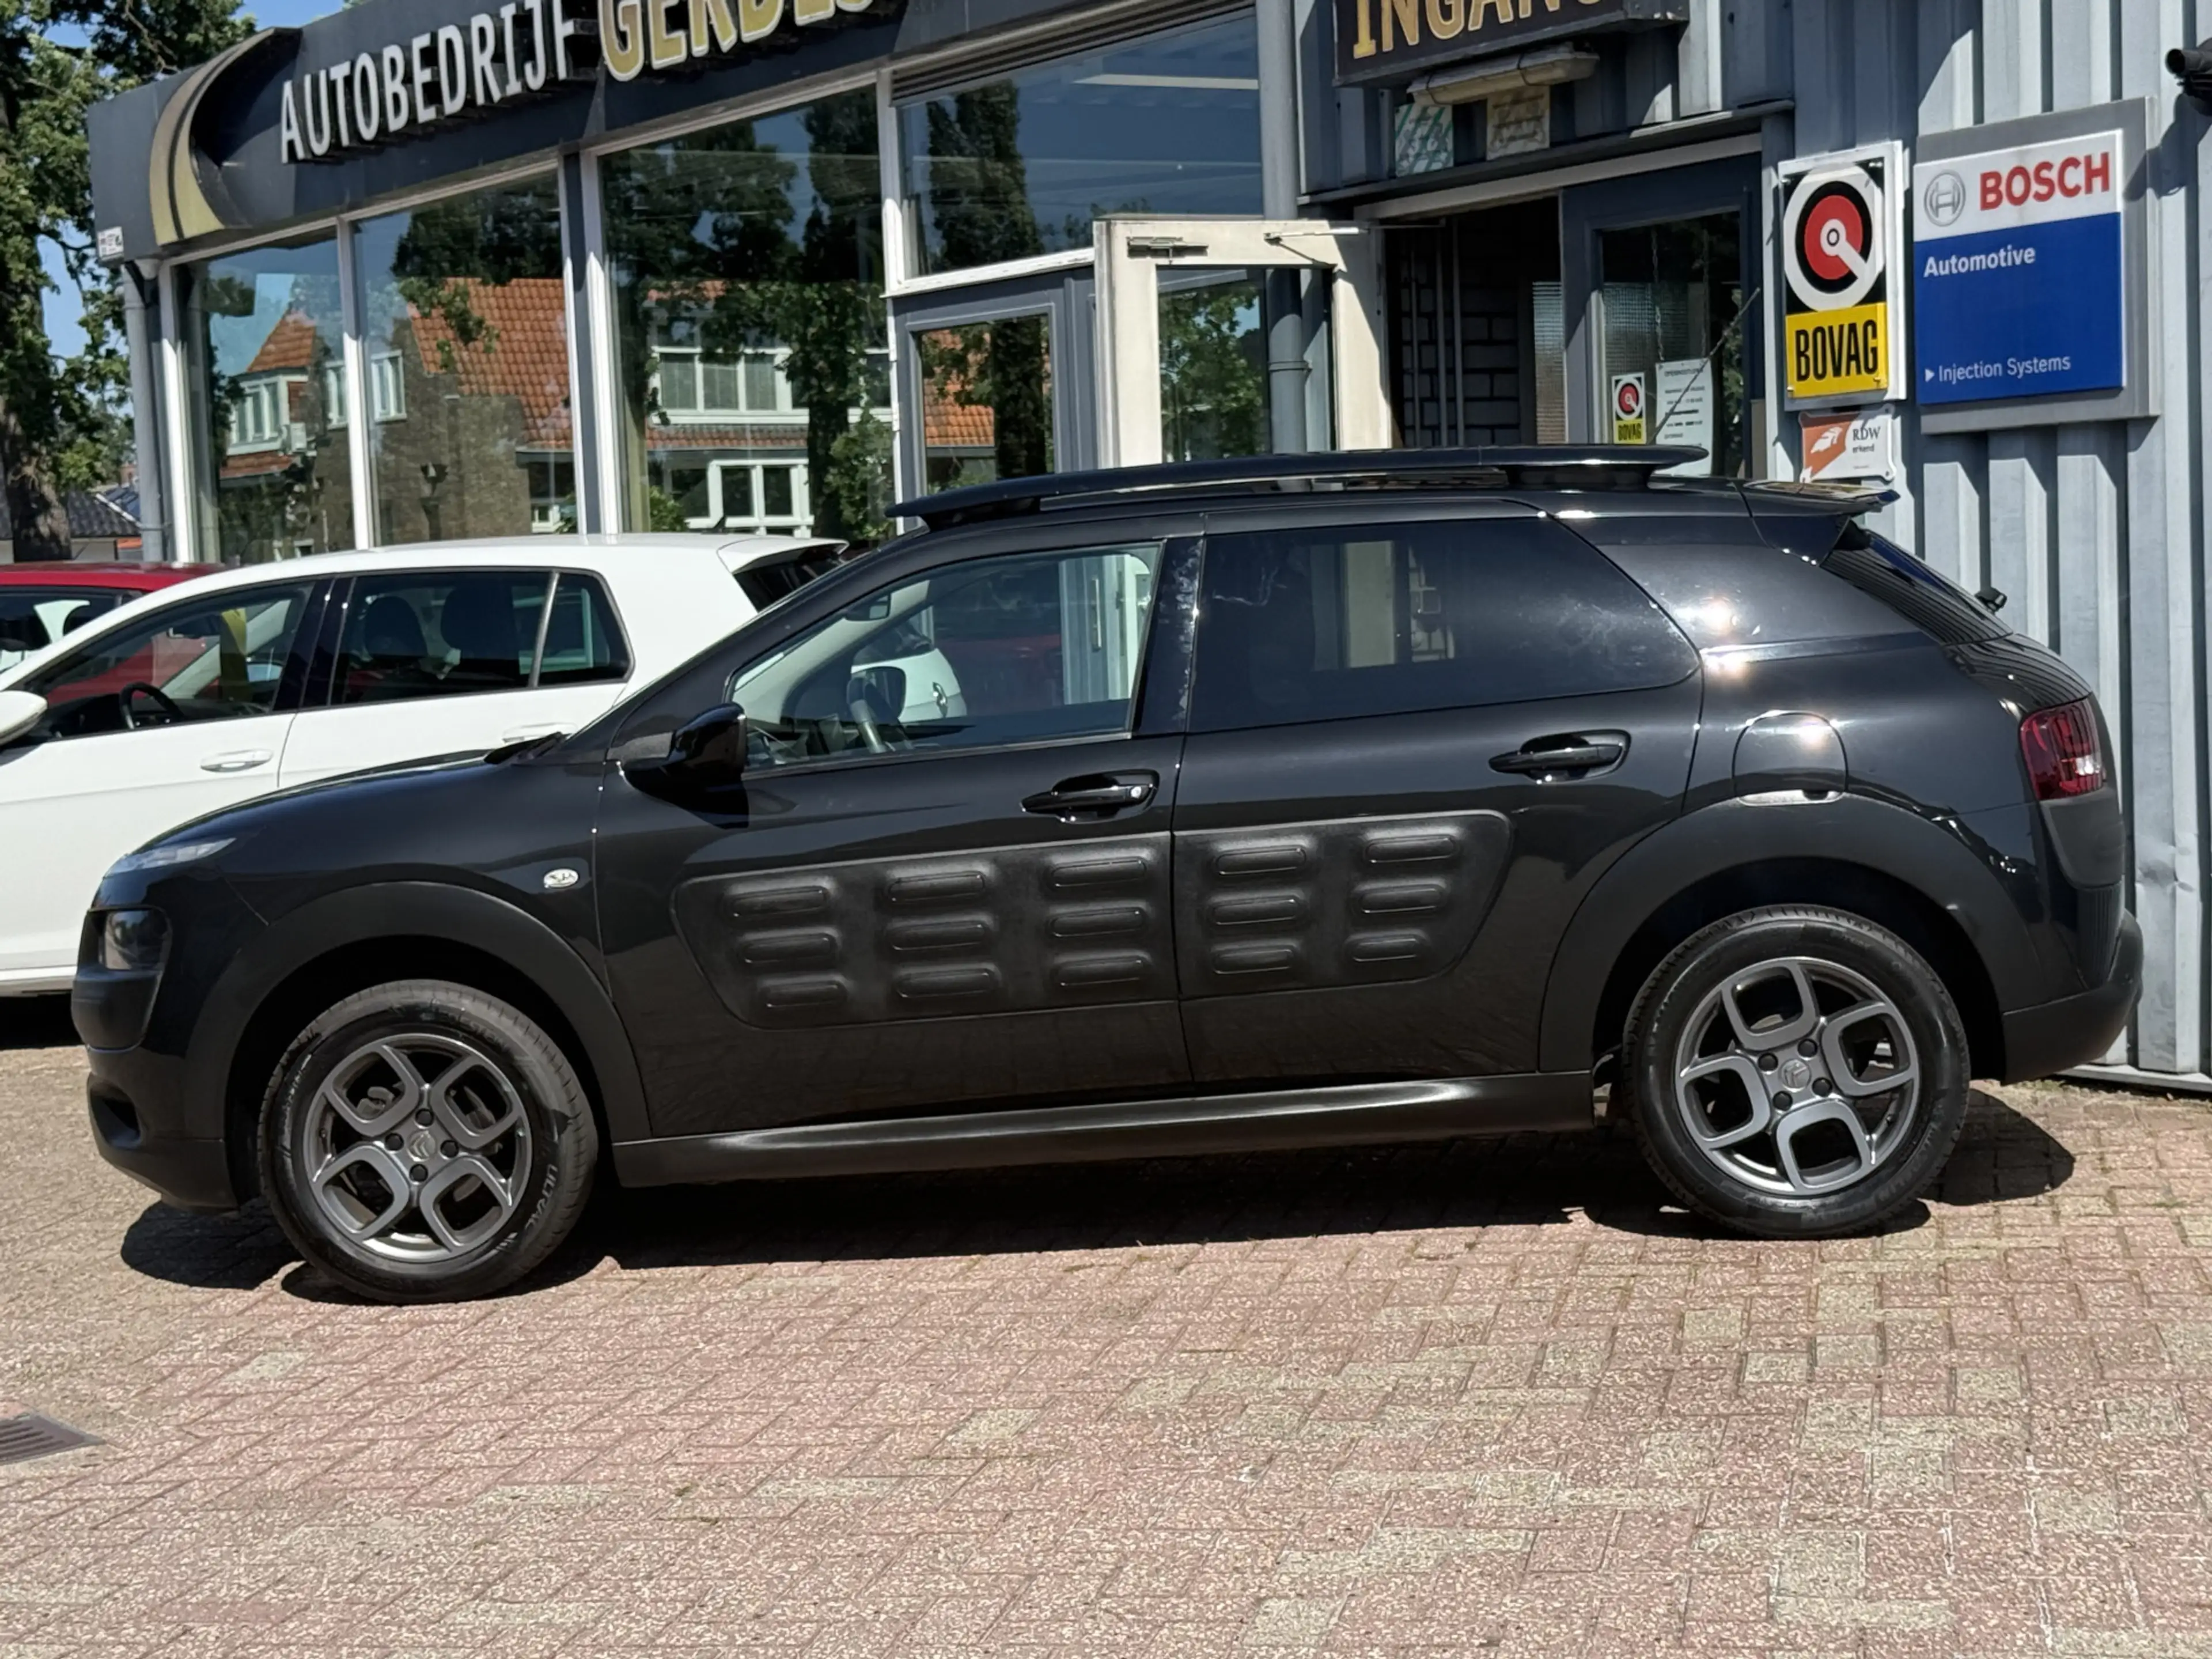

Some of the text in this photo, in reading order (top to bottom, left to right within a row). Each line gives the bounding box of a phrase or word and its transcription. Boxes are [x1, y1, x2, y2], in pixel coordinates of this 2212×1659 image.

[282, 0, 574, 164] AUTOBEDRIJF
[1980, 151, 2109, 211] BOSCH
[1923, 244, 2036, 278] Automotive
[1795, 319, 1878, 382] BOVAG
[1938, 357, 2071, 385] Injection Systems
[1618, 423, 1642, 442] BOVAG
[1852, 426, 1881, 441] RDW
